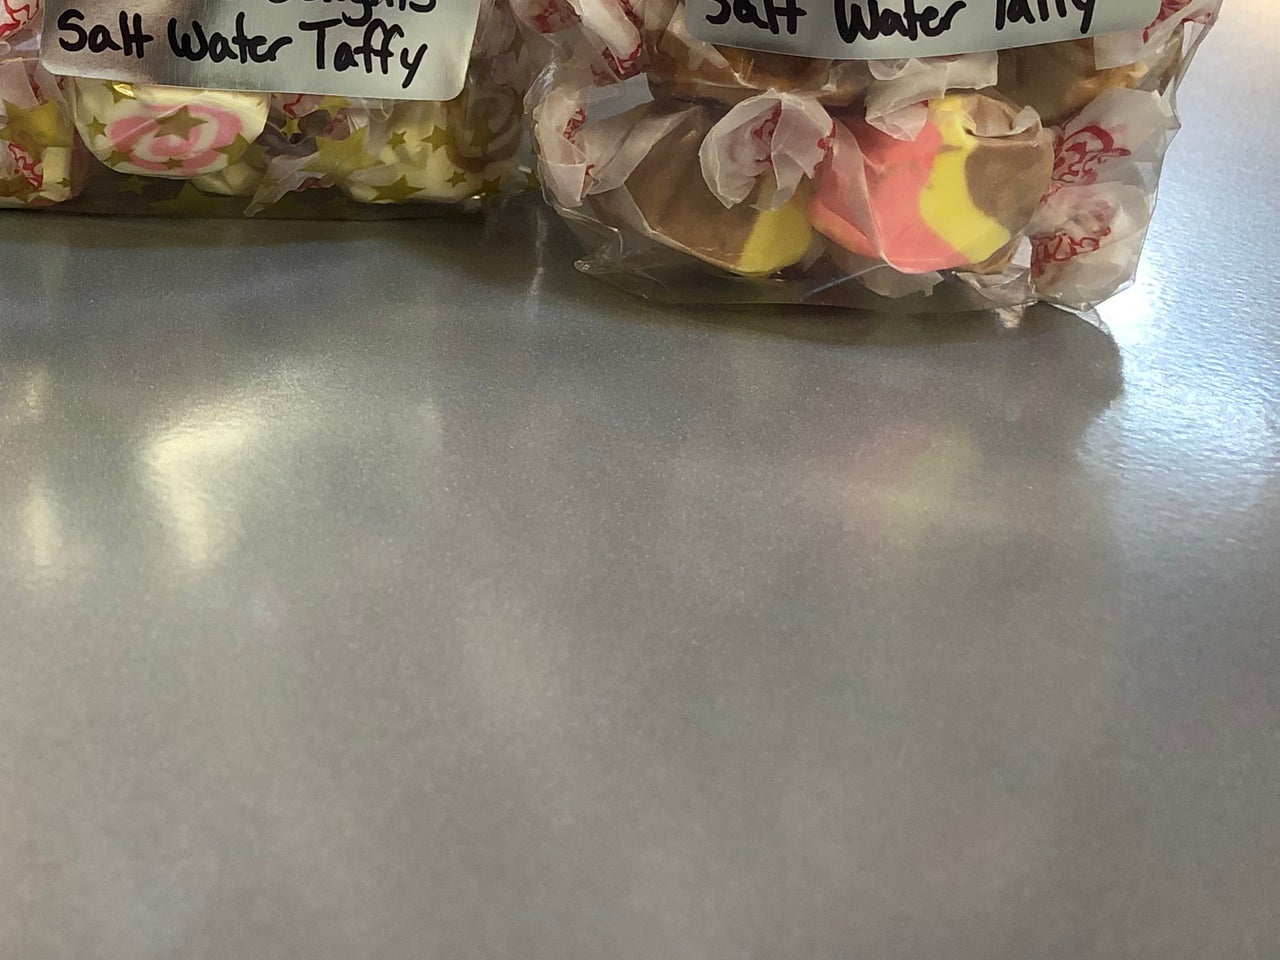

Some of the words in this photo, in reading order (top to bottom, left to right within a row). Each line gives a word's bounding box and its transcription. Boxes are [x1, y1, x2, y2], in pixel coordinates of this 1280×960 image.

[58, 9, 154, 59] Salt
[168, 12, 293, 64] Water
[299, 18, 429, 89] Taffy
